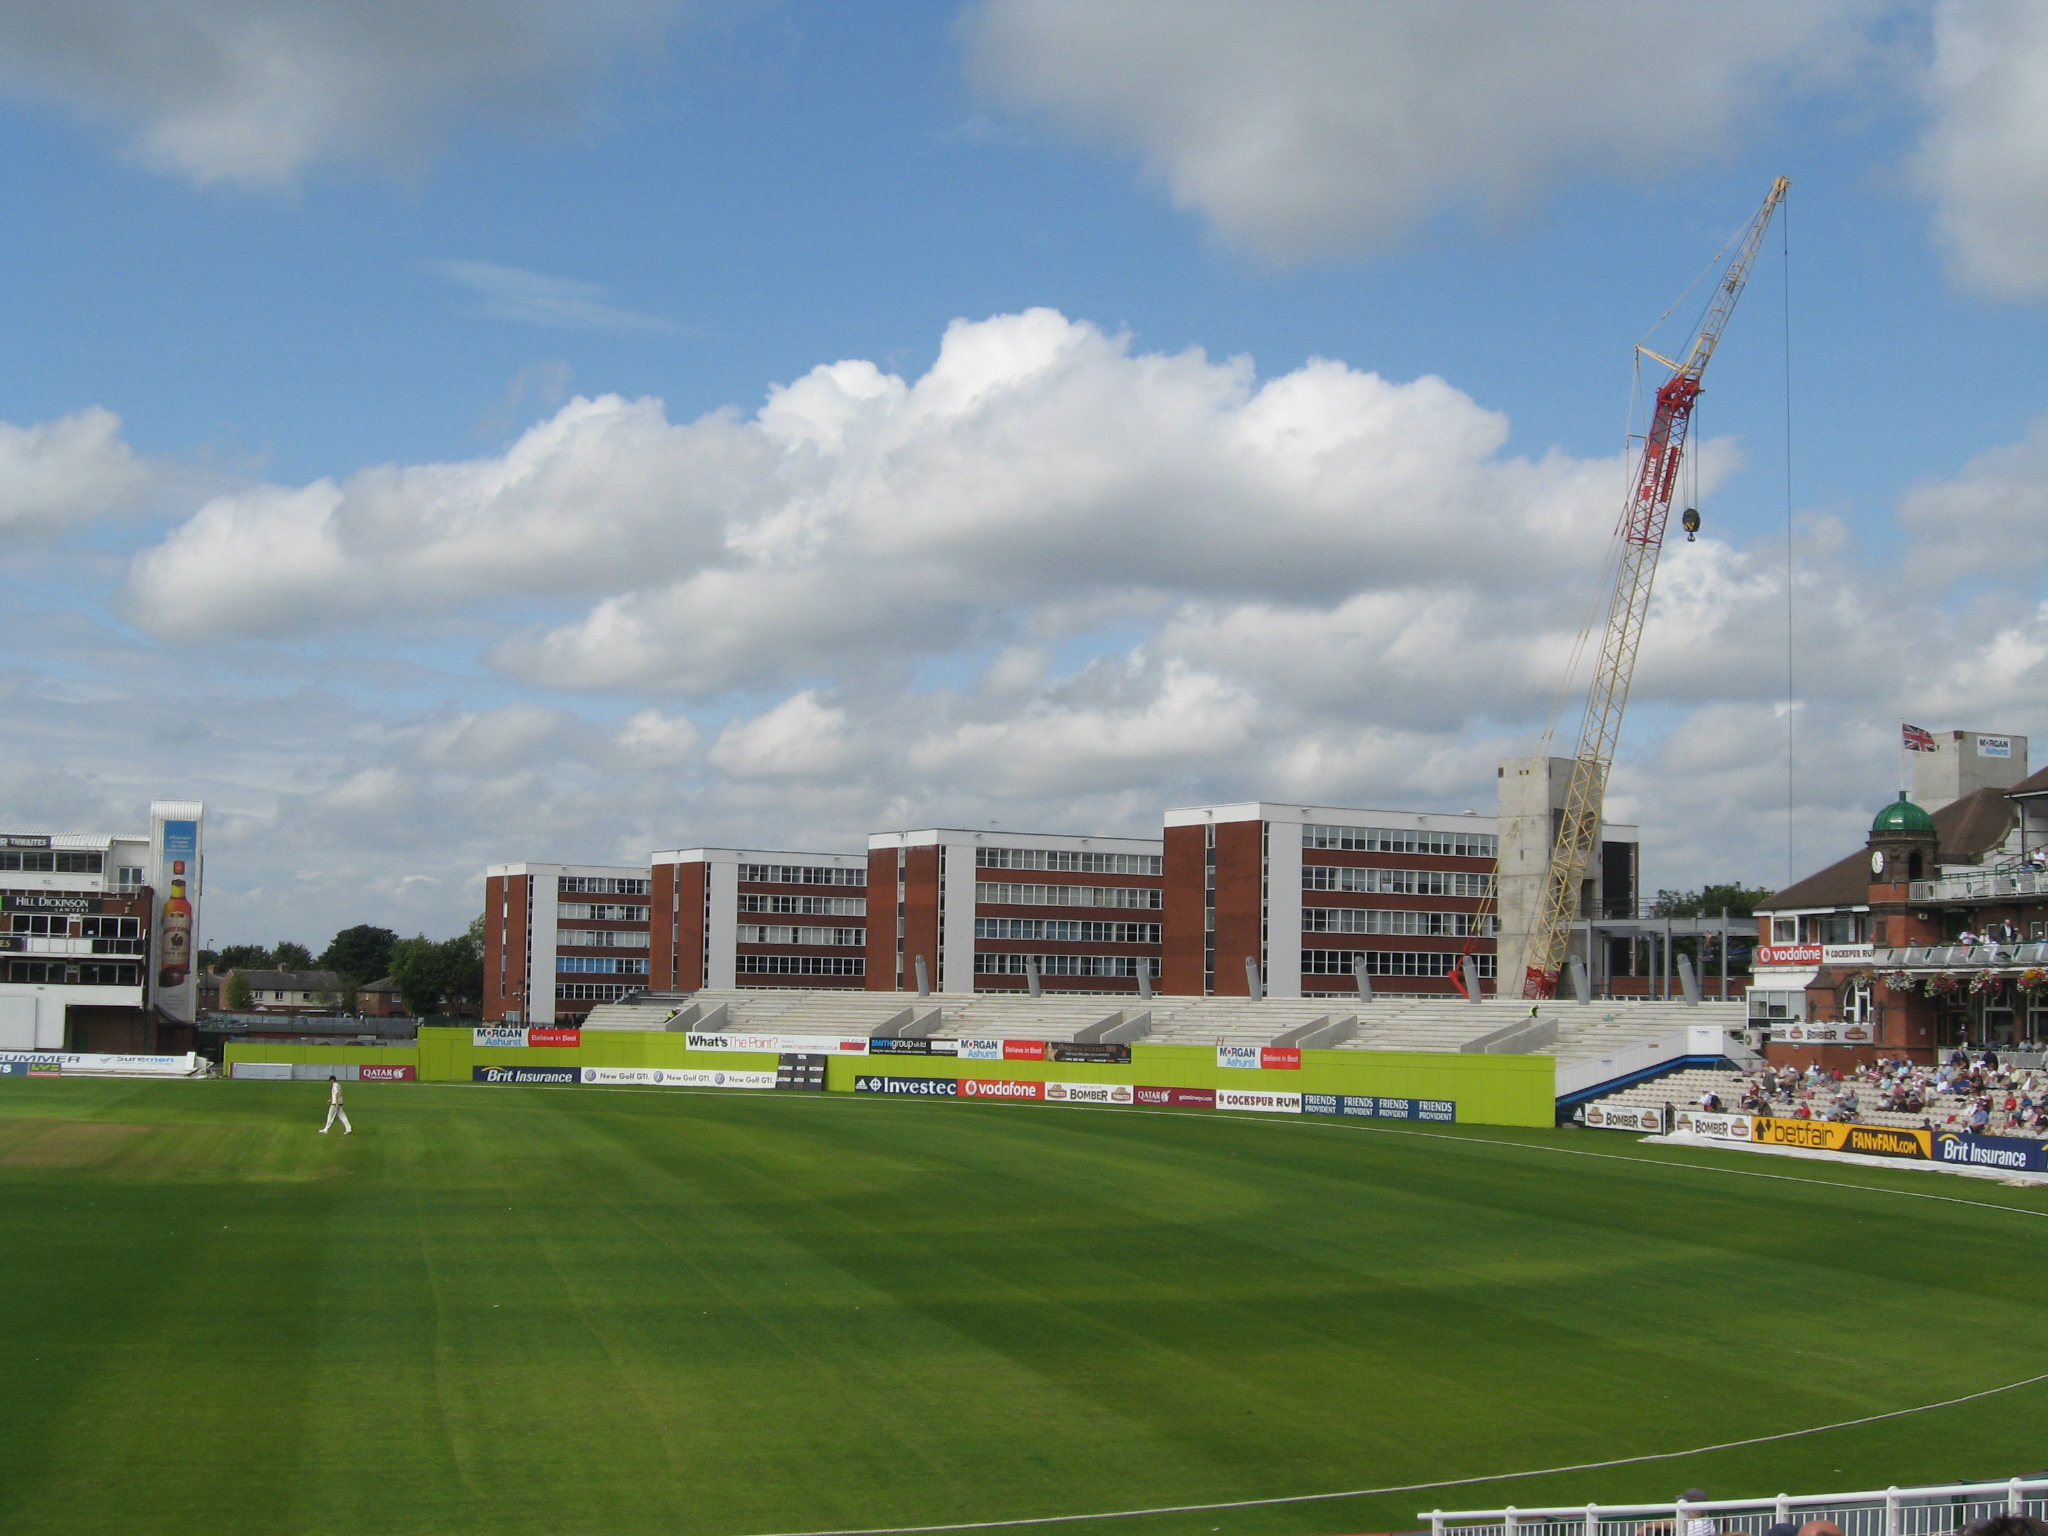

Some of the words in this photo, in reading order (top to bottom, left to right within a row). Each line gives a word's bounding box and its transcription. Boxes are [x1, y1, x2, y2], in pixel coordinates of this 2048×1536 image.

[1980, 739, 2008, 748] MORGAN
[10, 838, 47, 846] THWAITES
[1773, 947, 1821, 961] vodafone
[1831, 950, 1861, 958] COCKSPUR
[477, 1029, 522, 1038] MORGAN
[531, 1034, 554, 1042] Believe
[485, 1037, 522, 1046] Ashurst
[688, 1035, 728, 1047] What's
[728, 1036, 748, 1048] The
[749, 1037, 778, 1049] Point?
[961, 1040, 998, 1049] MORGAN
[968, 1049, 998, 1058] Ashurst
[1005, 1046, 1024, 1054] Believe
[1220, 1048, 1256, 1057] MORGAN
[116, 1055, 175, 1063] Suremen
[1226, 1057, 1255, 1067] Ashurst
[1263, 1054, 1282, 1062] Believe
[363, 1068, 393, 1078] QATAR
[487, 1069, 513, 1082] Brit
[515, 1070, 573, 1083] Insurance
[600, 1072, 617, 1080] New
[619, 1072, 635, 1080] Golf
[683, 1074, 697, 1082] Golf
[745, 1076, 760, 1084] Golf
[884, 1077, 957, 1095] Investec
[978, 1081, 1037, 1097] vodafone
[1070, 1089, 1108, 1101] BOMBER
[1138, 1090, 1161, 1100] QATAR
[1226, 1095, 1274, 1106] COCKSPUR
[1276, 1097, 1300, 1107] RUM
[1305, 1095, 1336, 1105] FRIENDS
[1344, 1097, 1373, 1108] FRIENDS
[1379, 1098, 1409, 1109] FRIENDS
[1305, 1105, 1336, 1114] PROVIDENT
[1419, 1101, 1453, 1112] FRIENDS
[1344, 1107, 1373, 1116] PROVIDENT
[1379, 1109, 1409, 1118] PROVIDENT
[1419, 1112, 1452, 1121] PROVIDENT
[1606, 1113, 1638, 1128] BOMBER
[1695, 1120, 1729, 1136] BOMBER
[1774, 1120, 1834, 1146] betfair
[1943, 1140, 1969, 1162] Brit
[1970, 1142, 2027, 1167] Insurance
